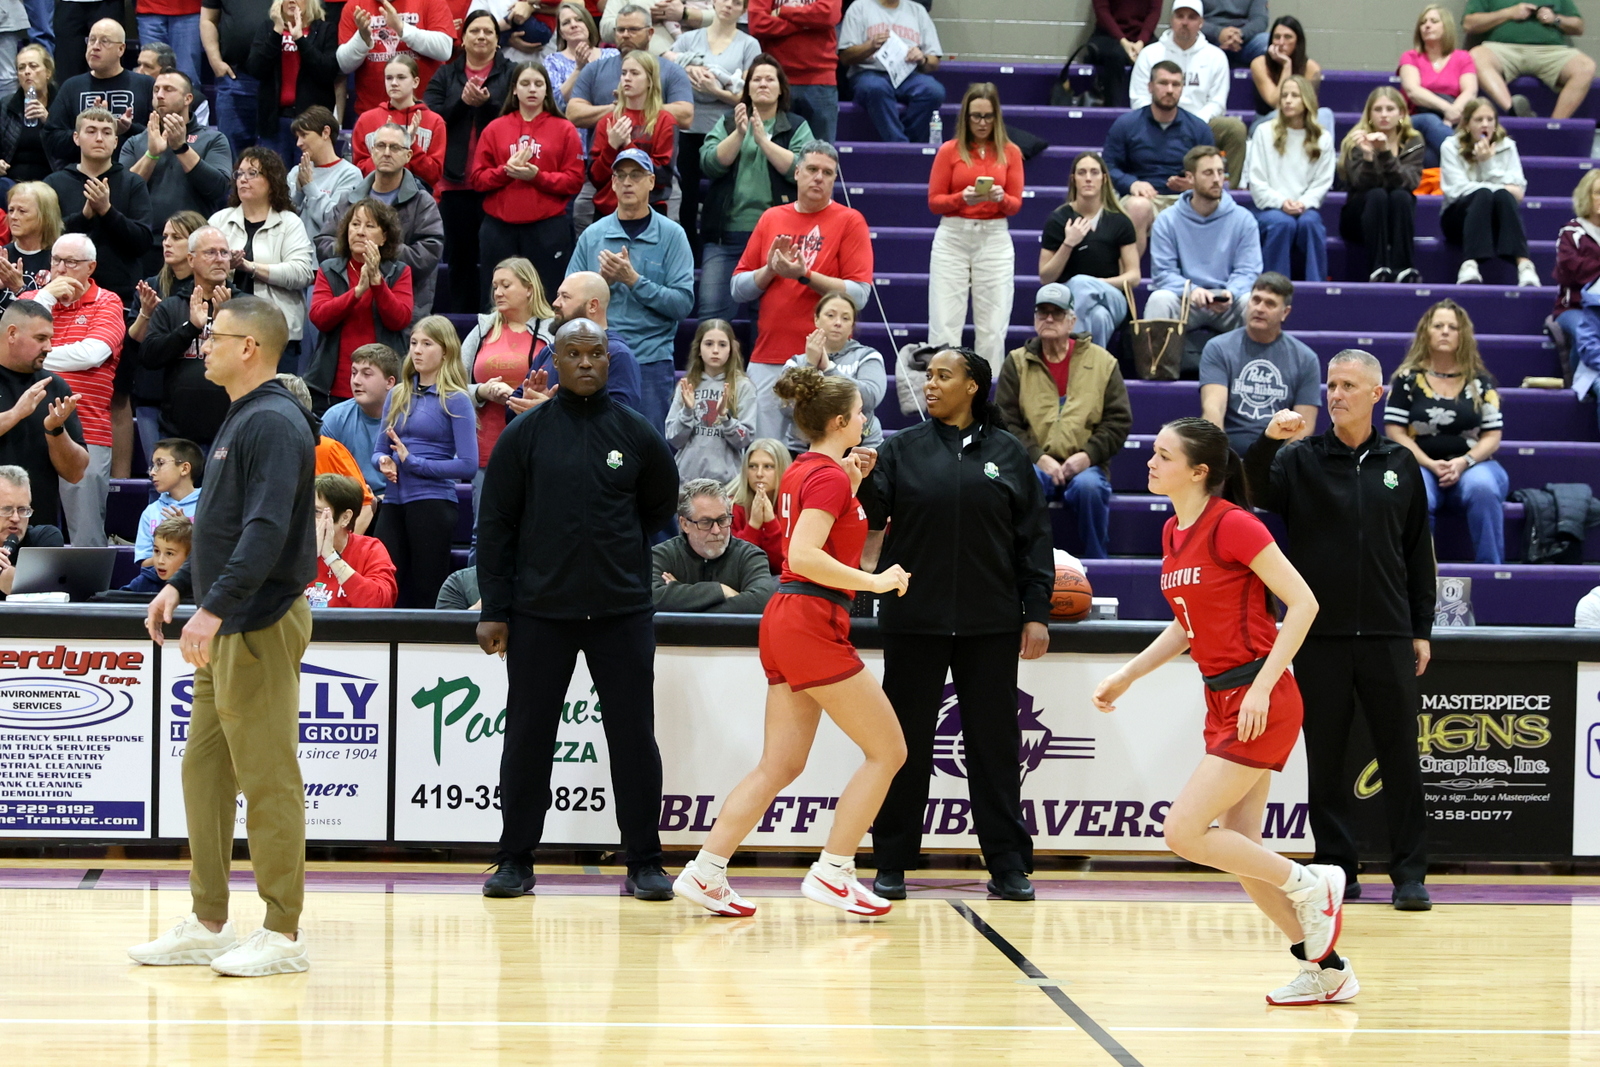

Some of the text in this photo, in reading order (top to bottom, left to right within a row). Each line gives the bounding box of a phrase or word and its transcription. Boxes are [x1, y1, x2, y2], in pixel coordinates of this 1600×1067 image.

[1247, 366, 1274, 383] Pabst
[1234, 379, 1254, 394] Blue
[1254, 383, 1285, 397] Ribbon
[782, 493, 791, 538] 4
[98, 675, 141, 686] Corp.
[0, 690, 81, 699] NVIRONMENTAL
[12, 702, 62, 710] SERVICES
[1421, 694, 1551, 710] MASTERPIECE
[304, 725, 377, 741] GROUP
[56, 744, 111, 752] SERVICES
[305, 747, 340, 759] since
[345, 748, 378, 760] 1904
[1513, 755, 1550, 774] Inc.
[26, 781, 83, 789] CLEANING
[1, 790, 73, 798] DEMOLITION
[1424, 793, 1440, 803] buy
[1497, 793, 1551, 803] Masterpiece!
[1426, 810, 1512, 820] -358-0077
